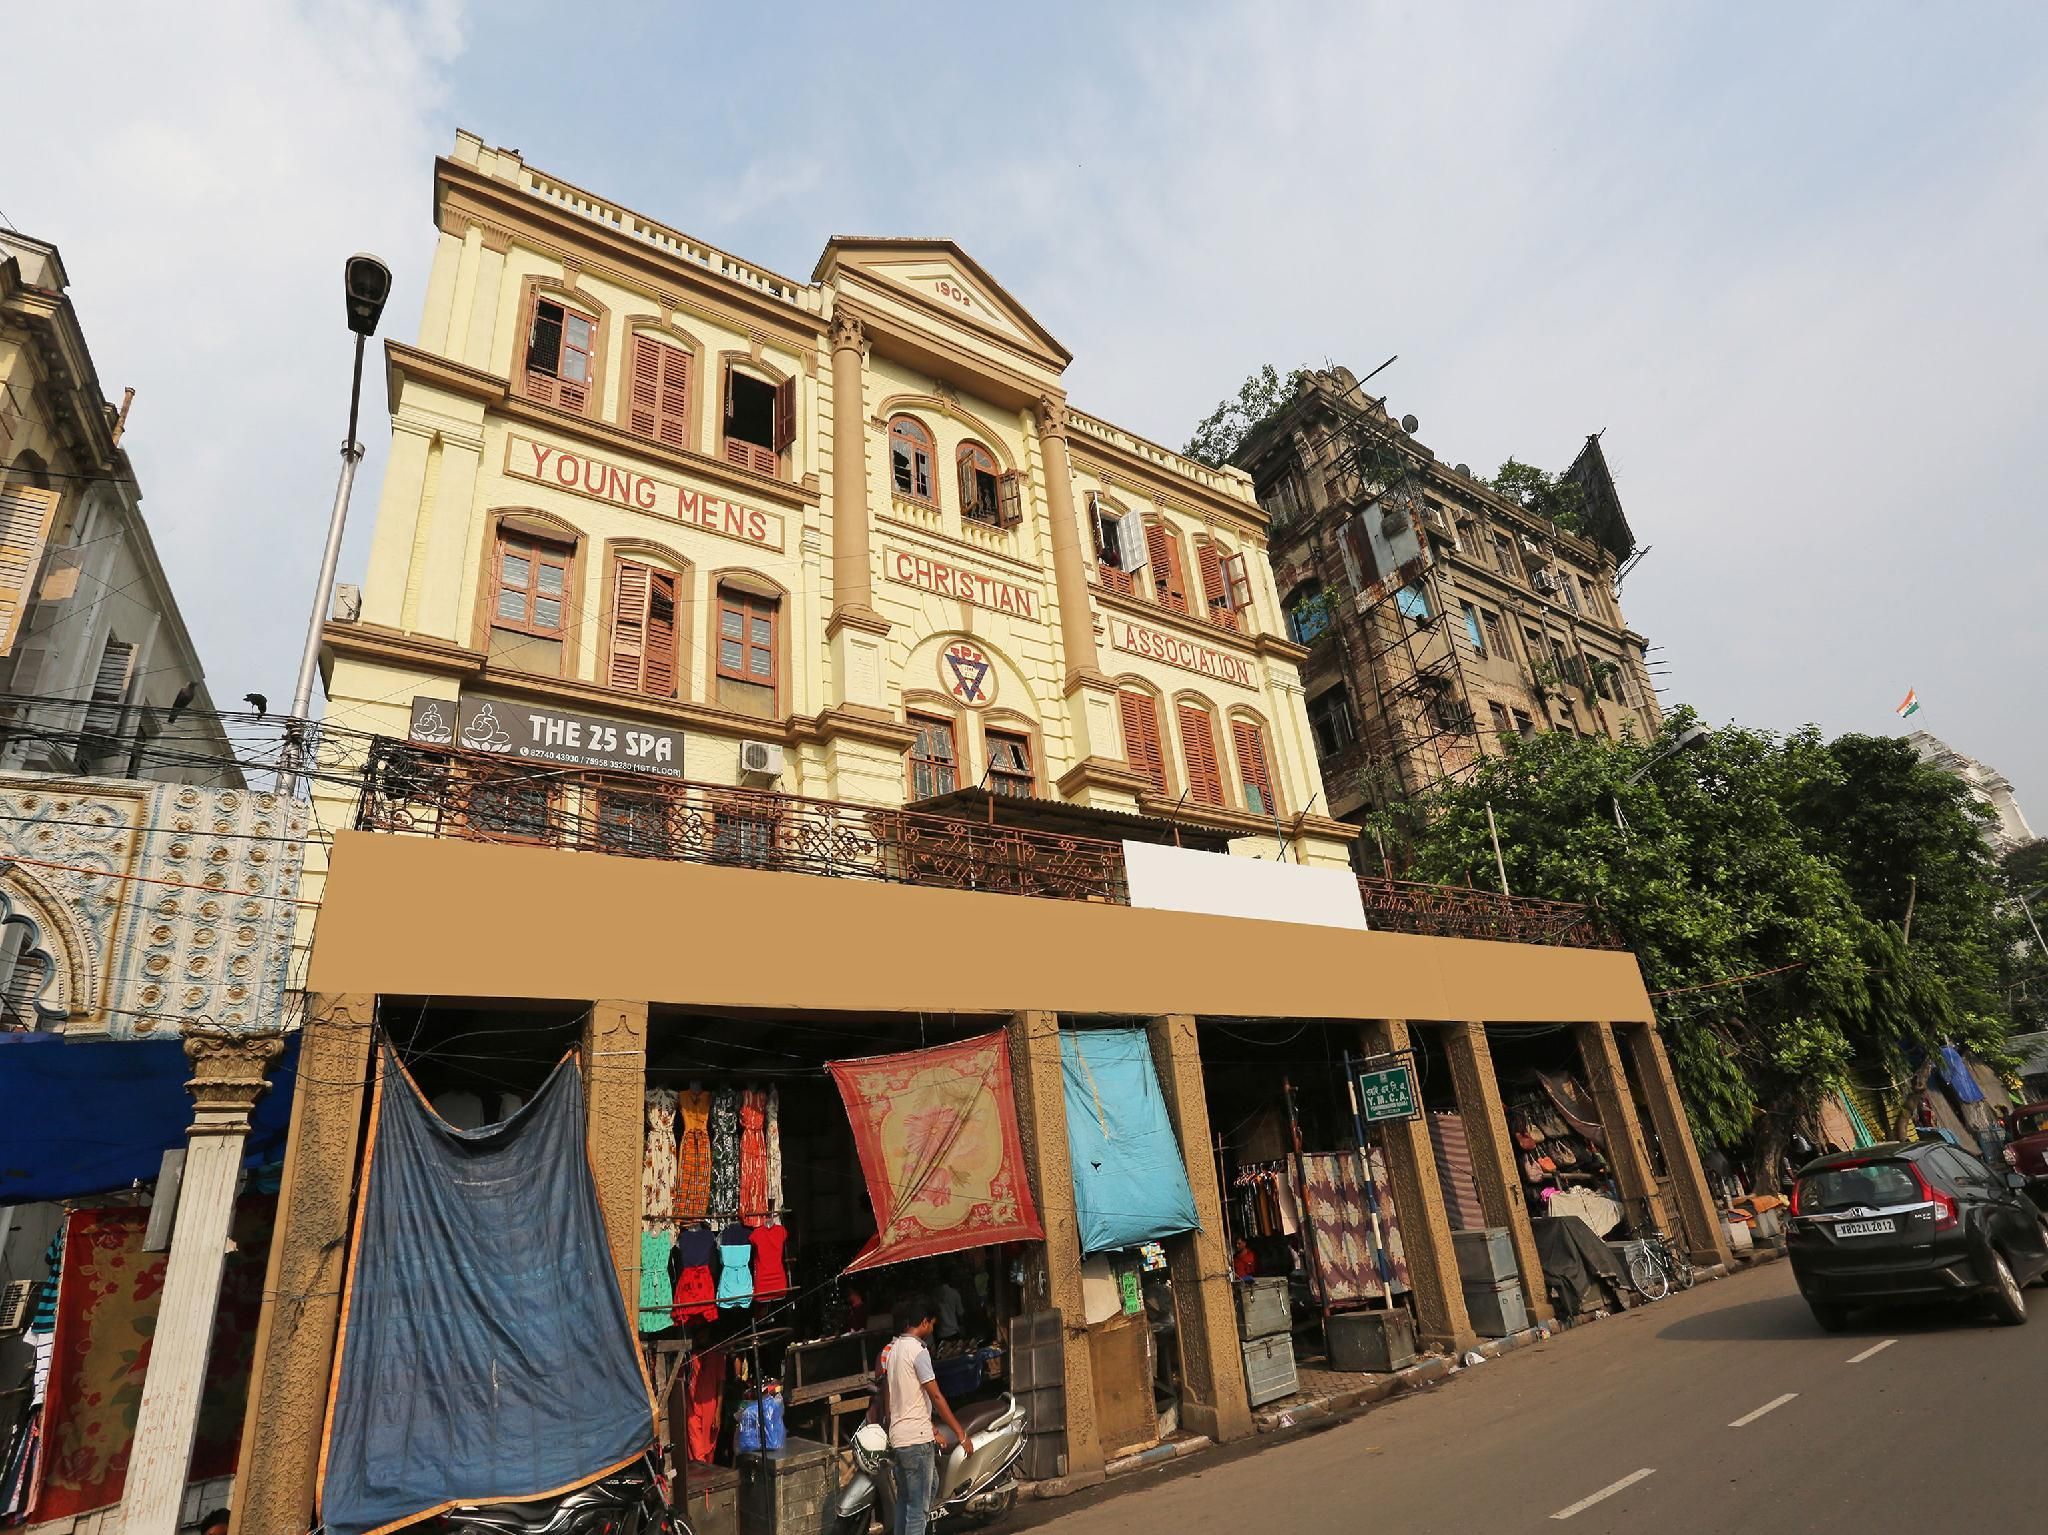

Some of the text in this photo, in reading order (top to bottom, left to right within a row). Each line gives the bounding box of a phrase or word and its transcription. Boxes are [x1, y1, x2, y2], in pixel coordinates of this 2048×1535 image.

[531, 443, 767, 541] YOUNG MENS
[896, 553, 1033, 616] CHRISTIAN
[1125, 625, 1250, 685] ASSOCIATION
[529, 715, 673, 763] THE 25 SPA
